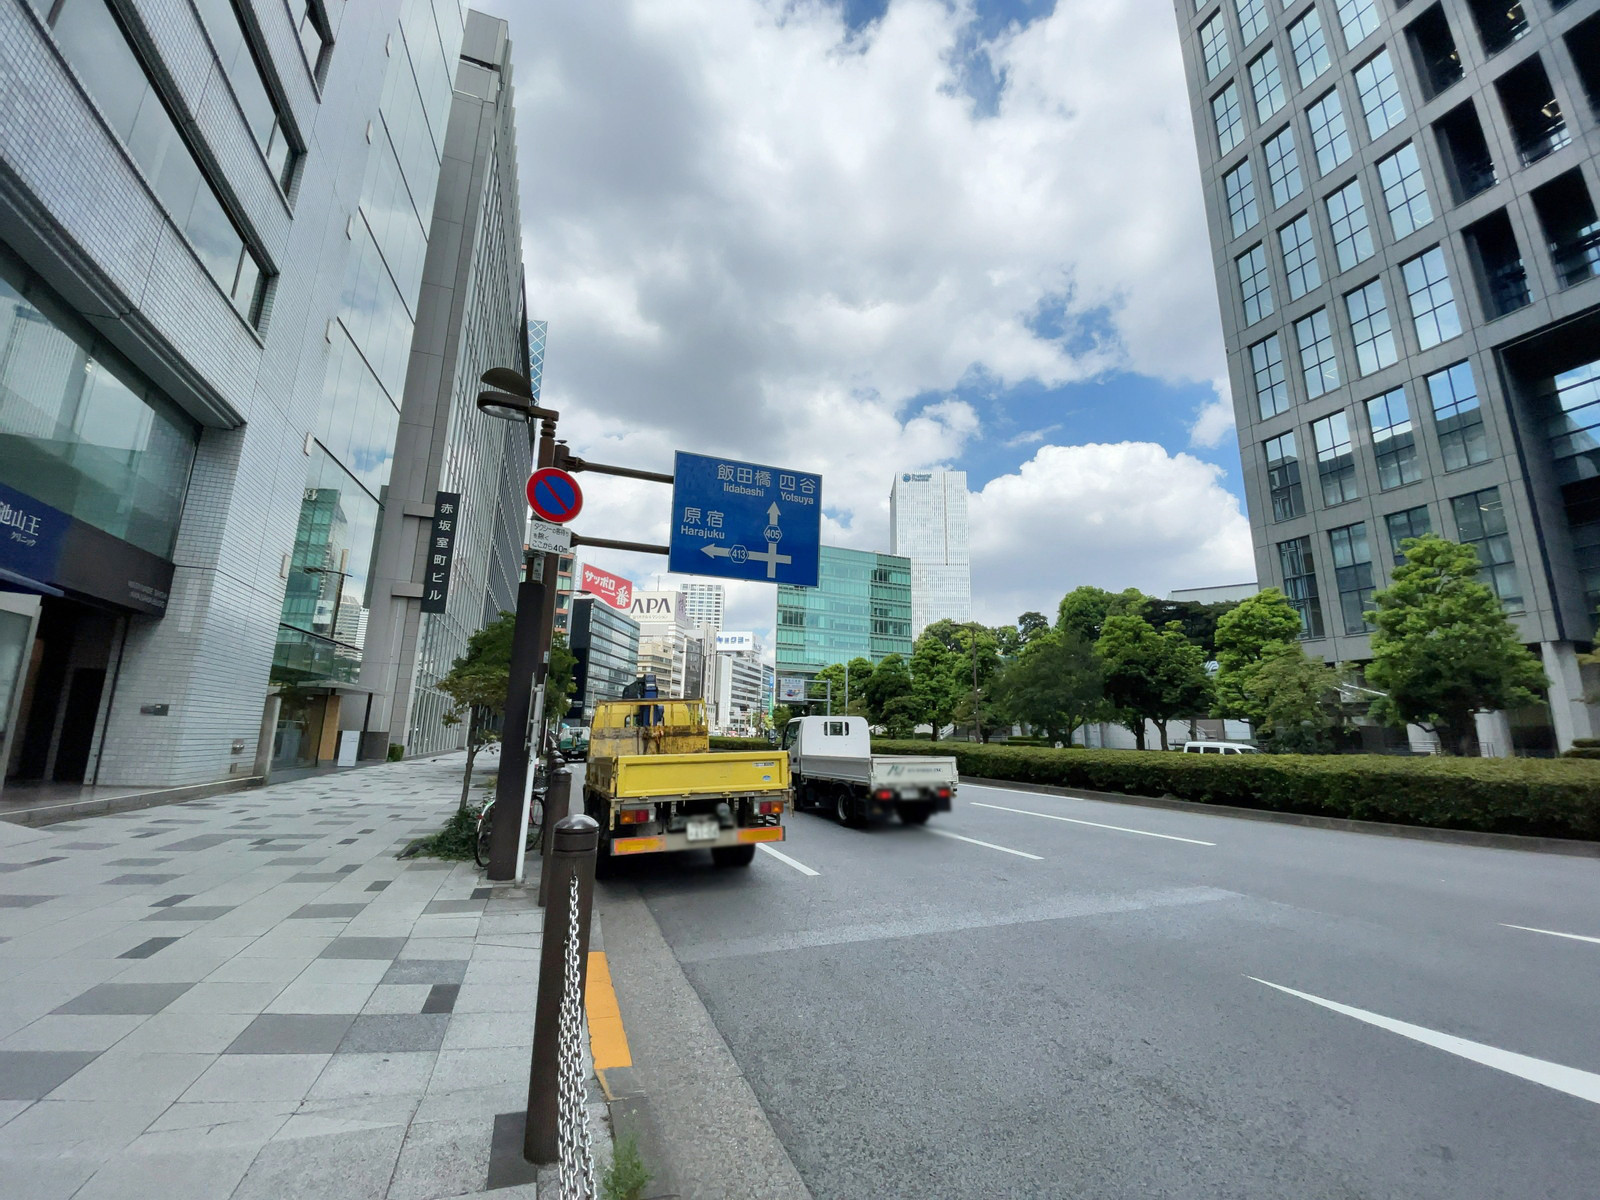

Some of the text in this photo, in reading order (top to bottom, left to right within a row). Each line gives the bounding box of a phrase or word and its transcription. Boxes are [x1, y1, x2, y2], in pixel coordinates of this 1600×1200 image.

[716, 463, 816, 494] 飯田橋 四谷
[723, 482, 814, 505] Iidabashi Yotsuya
[683, 506, 724, 528] 原宿
[680, 525, 725, 540] Harajuku
[765, 529, 780, 539] 405
[429, 503, 453, 601] 赤坂室町ビル
[732, 549, 746, 559] 413
[585, 570, 616, 591] サッポロ
[601, 585, 630, 607] 一番
[630, 598, 671, 614] APA
